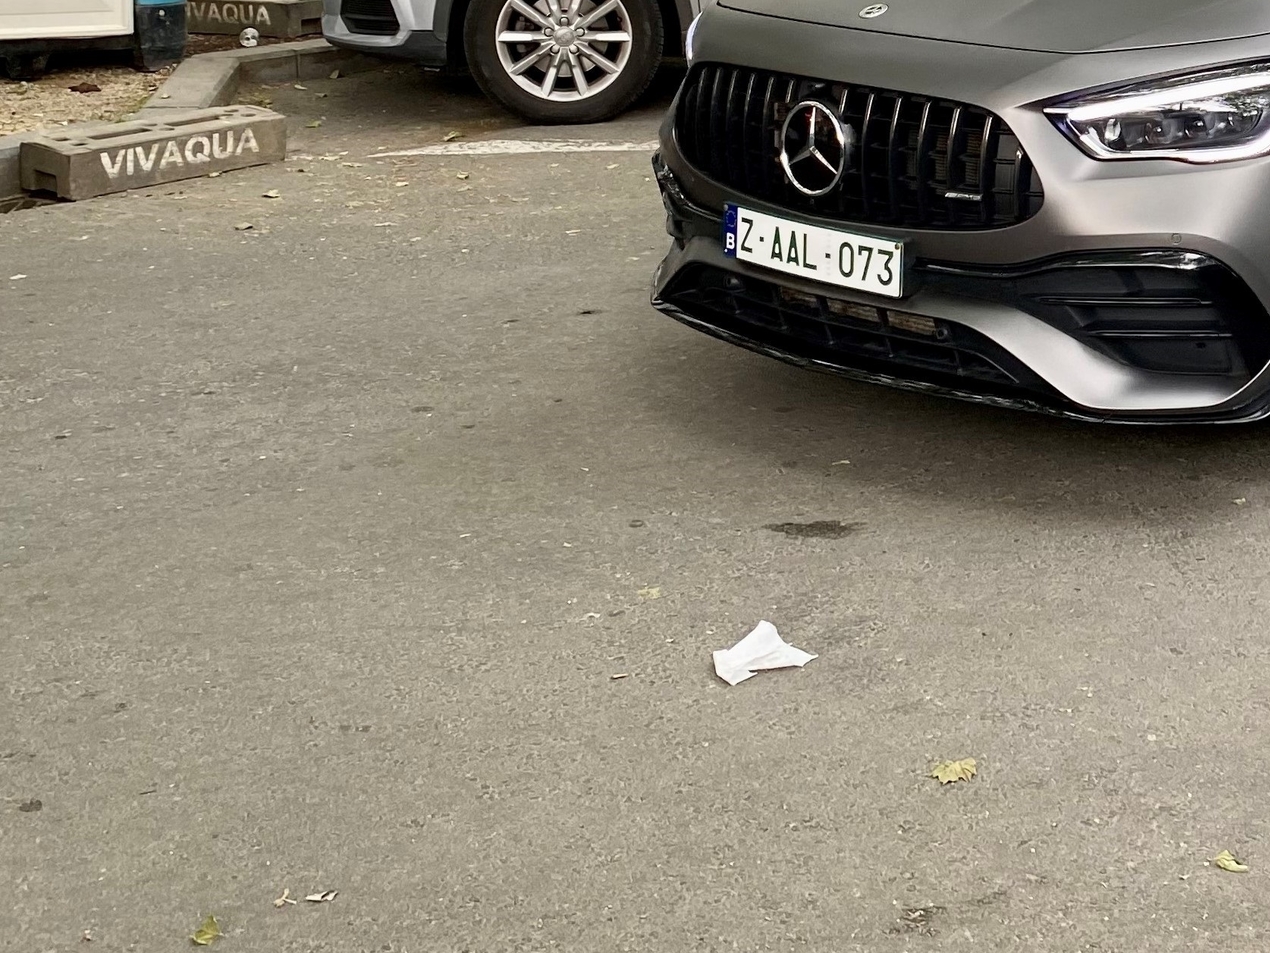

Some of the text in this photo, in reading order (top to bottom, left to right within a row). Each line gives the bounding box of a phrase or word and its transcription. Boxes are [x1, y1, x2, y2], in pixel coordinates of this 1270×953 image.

[185, 1, 271, 26] IVAQUA
[100, 127, 260, 179] VIVAQUA
[726, 232, 735, 250] B
